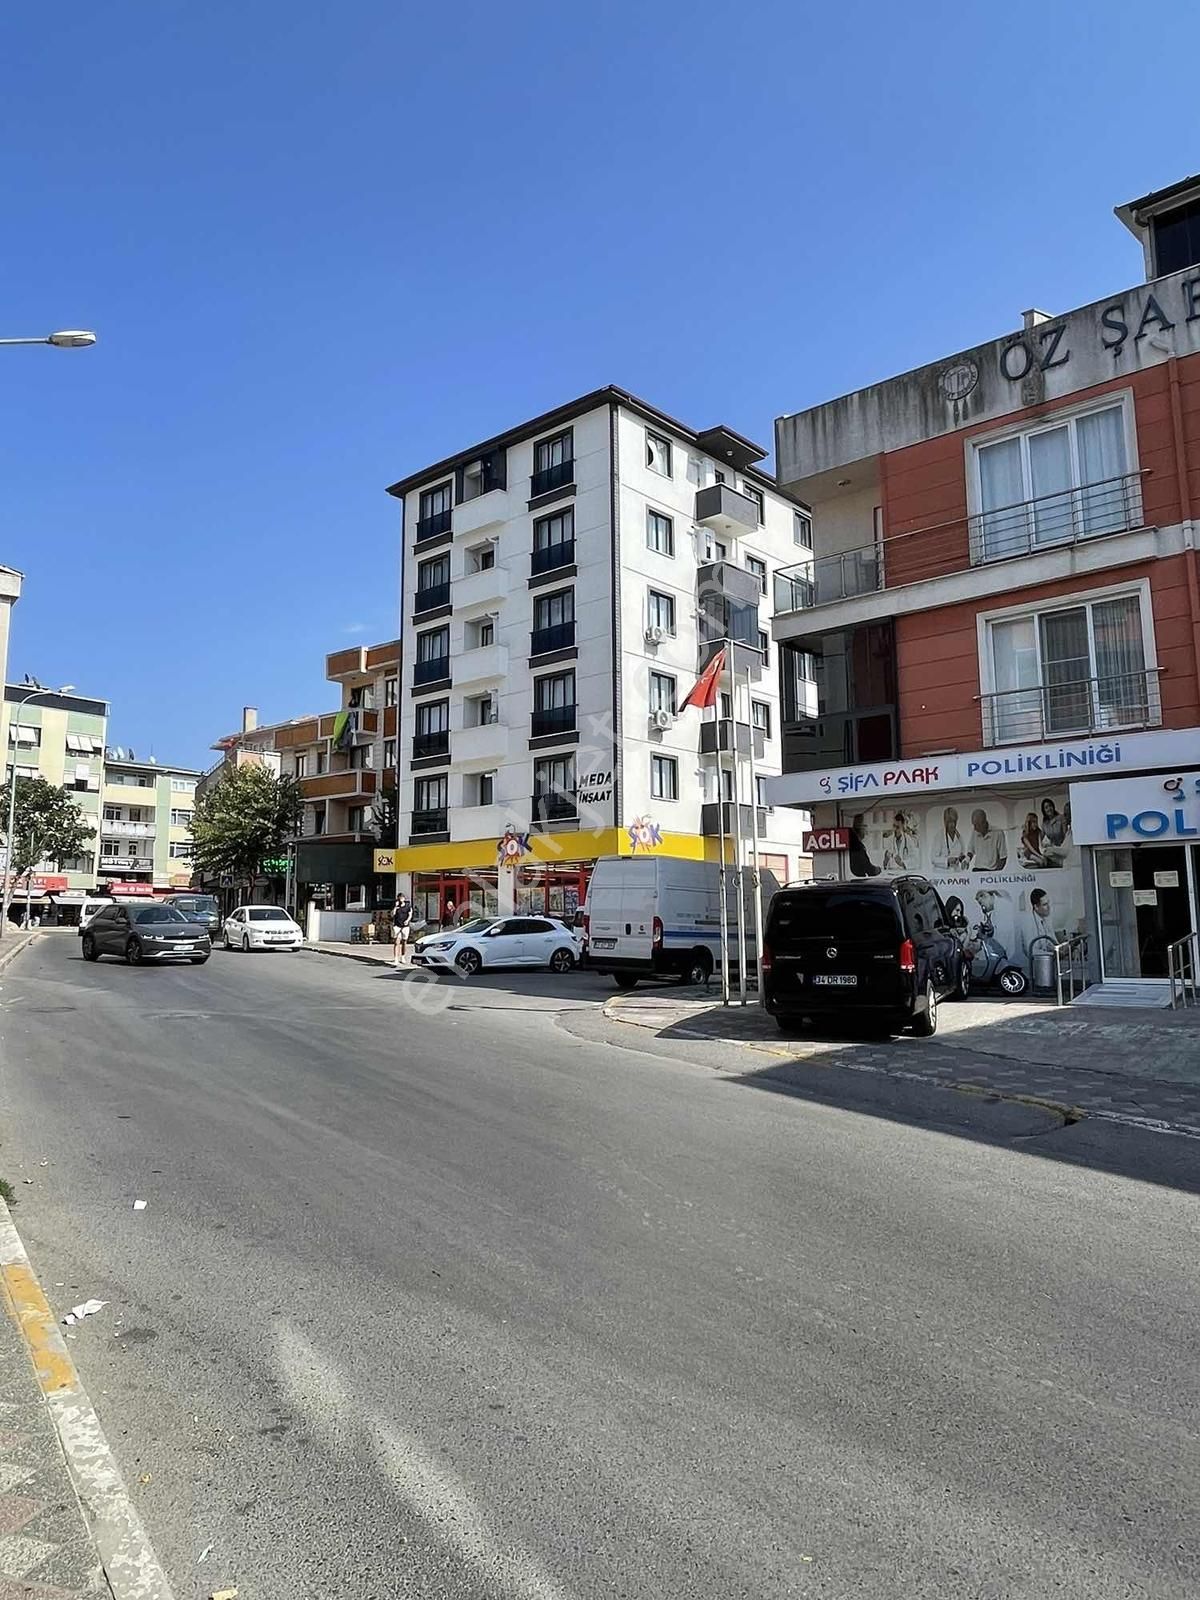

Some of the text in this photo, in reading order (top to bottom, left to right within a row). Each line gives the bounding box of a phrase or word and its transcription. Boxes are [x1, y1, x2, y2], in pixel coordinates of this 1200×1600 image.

[1001, 324, 1070, 381] ÖZ
[837, 743, 1121, 793] ŞİFA PARK POLİKLİNİĞİ
[579, 771, 612, 788] MEDA
[579, 790, 612, 804] İNŞAAT
[1106, 808, 1198, 839] POL
[806, 830, 847, 850] ACİL
[947, 877, 970, 886] PARK
[816, 975, 826, 984] 34
